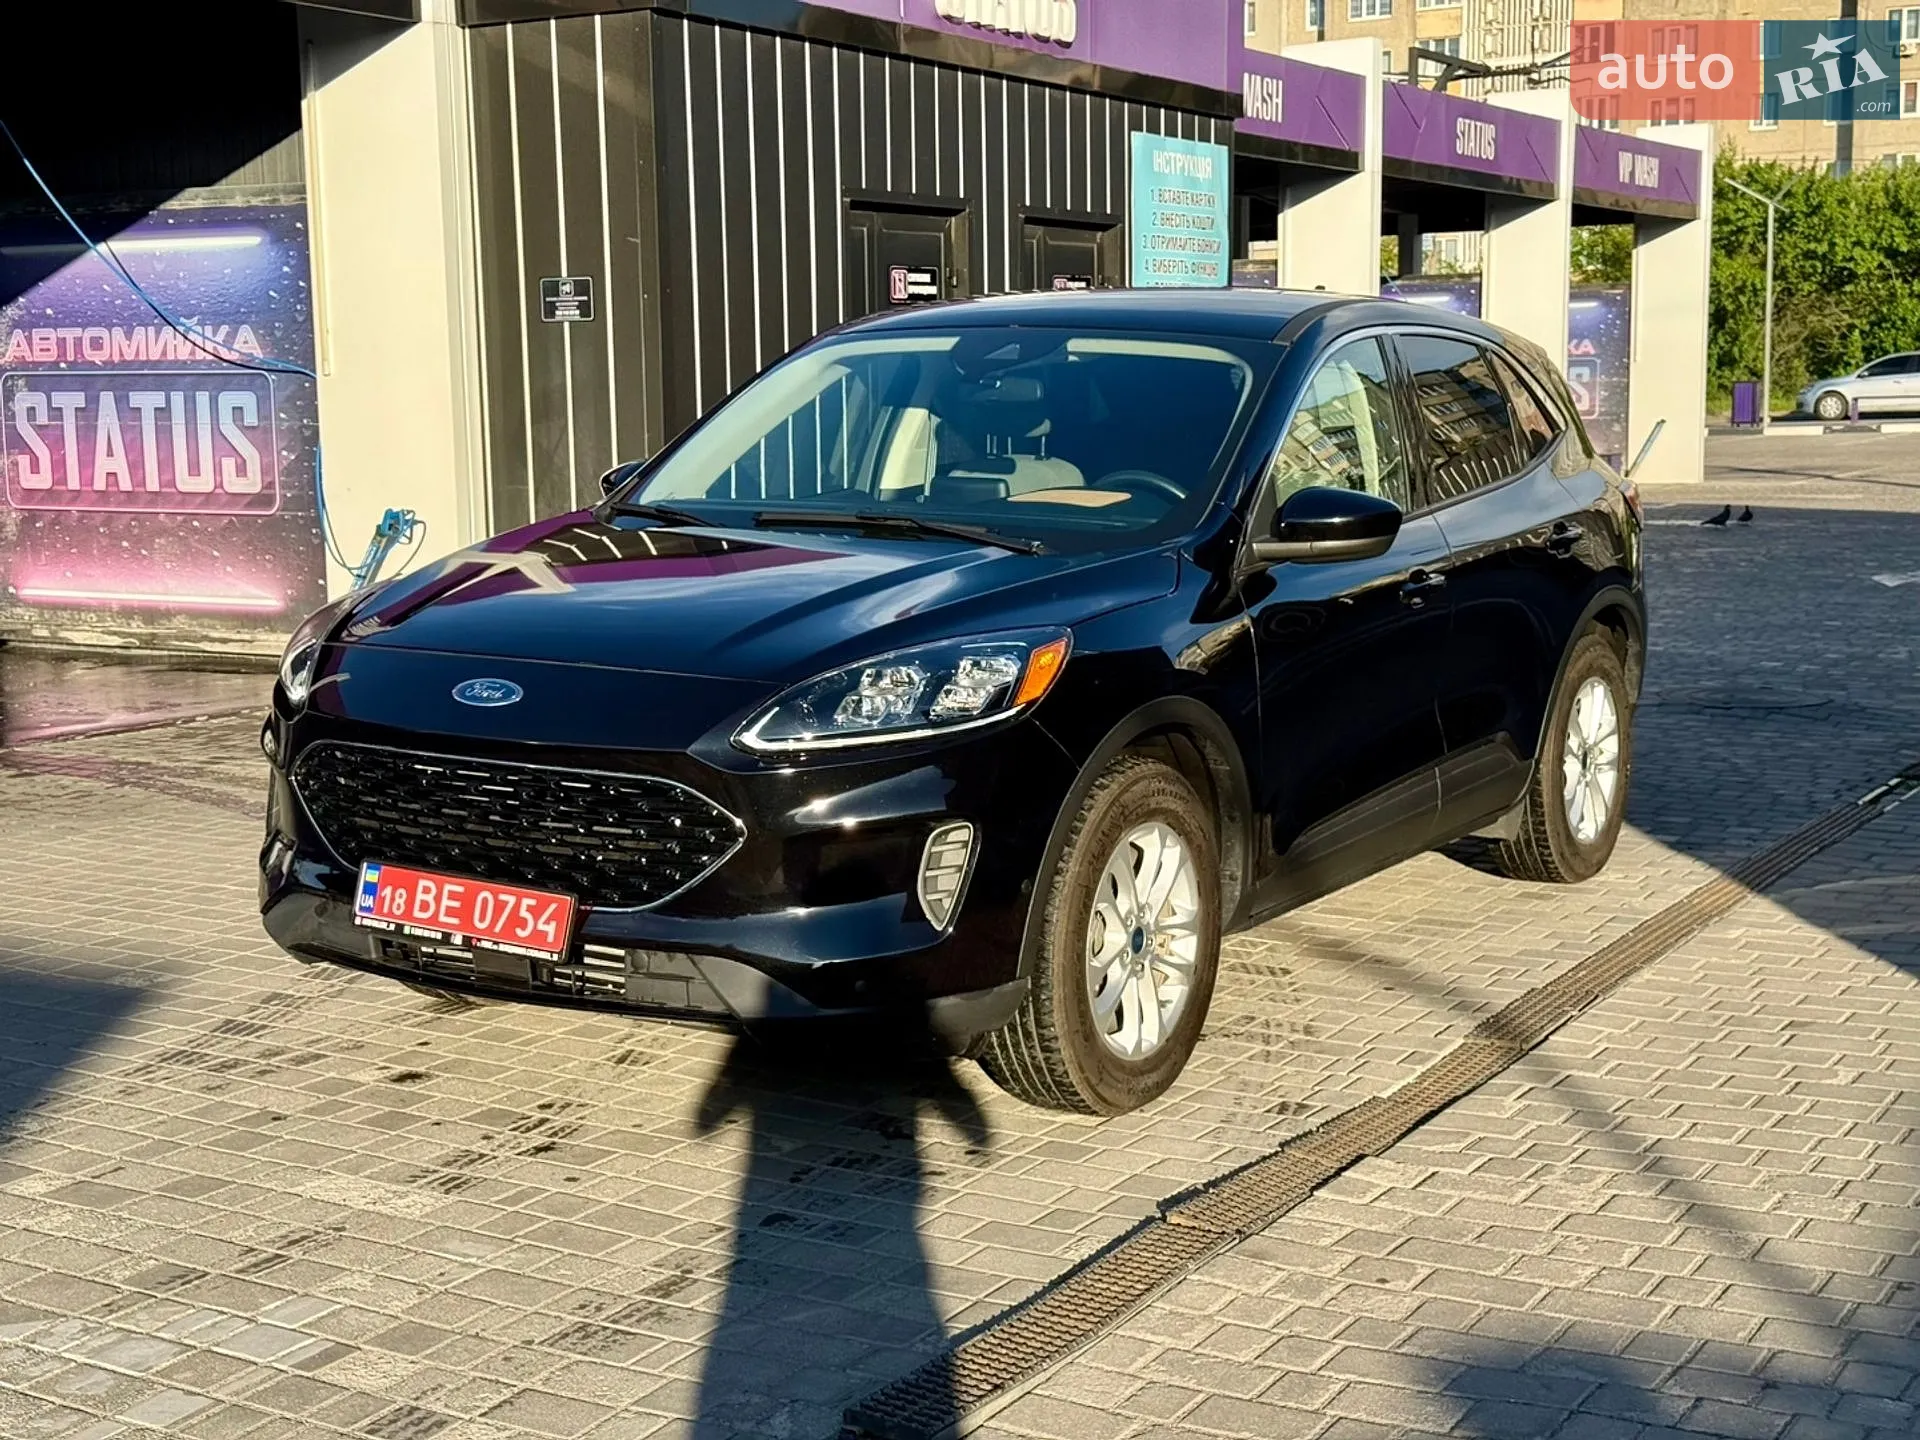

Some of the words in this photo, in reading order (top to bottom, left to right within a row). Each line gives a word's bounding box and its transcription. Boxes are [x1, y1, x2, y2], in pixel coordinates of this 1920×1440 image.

[1455, 117, 1496, 161] STATUS
[1634, 154, 1660, 189] WASH
[4, 316, 263, 363] АВТОМИЙКА
[14, 390, 263, 494] STATUS
[360, 893, 374, 909] UA
[380, 885, 407, 916] 18
[412, 878, 466, 926] BE
[473, 890, 560, 944] 0754
